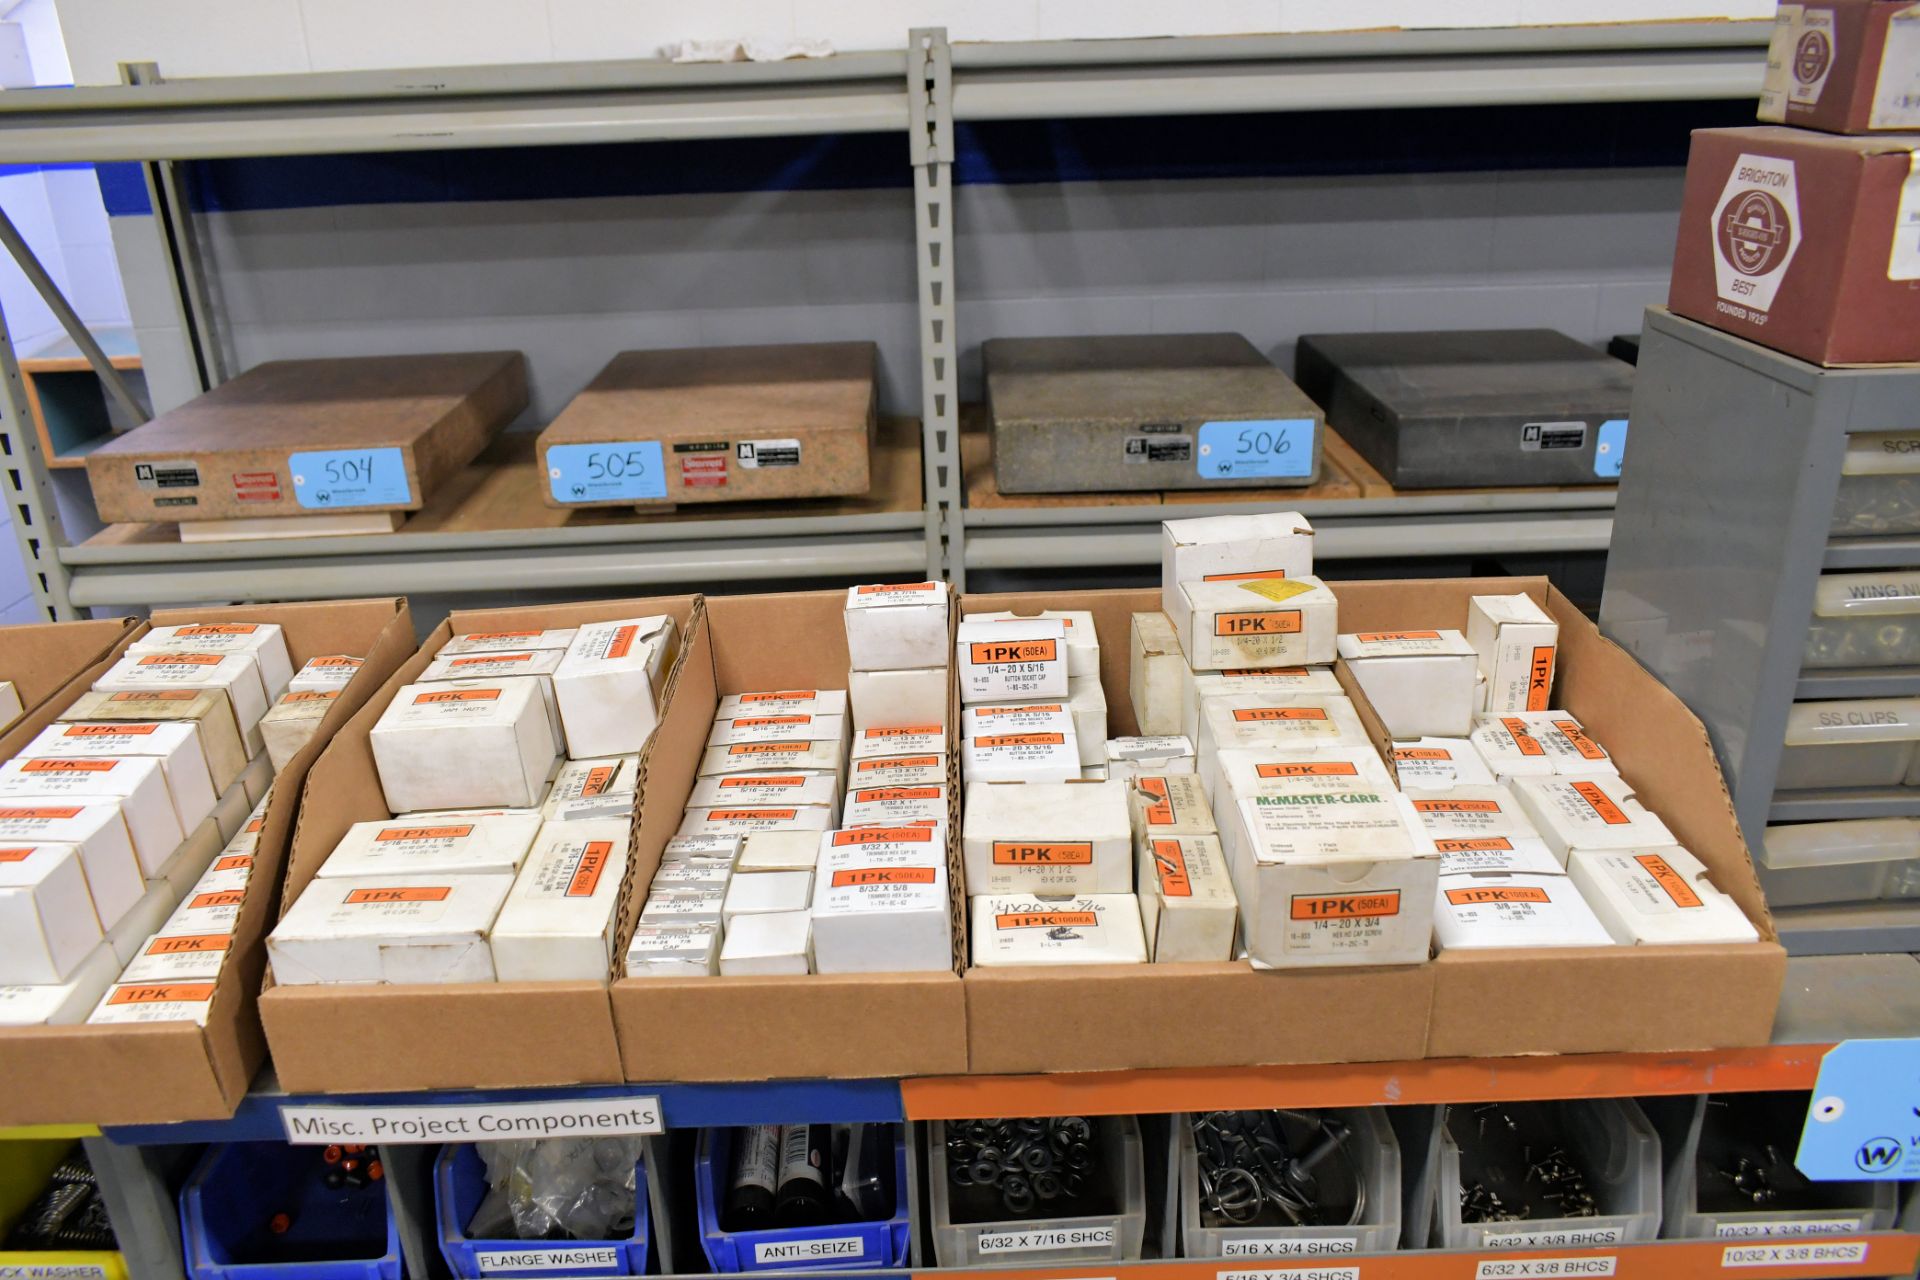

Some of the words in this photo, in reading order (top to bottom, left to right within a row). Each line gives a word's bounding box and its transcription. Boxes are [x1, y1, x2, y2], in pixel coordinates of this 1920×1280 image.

[1738, 167, 1789, 188] BRIGHTON
[1731, 279, 1757, 296] BEST
[1716, 301, 1746, 320] FOUNDED
[1236, 429, 1291, 454] 506
[325, 456, 373, 484] 504
[588, 452, 645, 479] 505
[1849, 585, 1898, 599] WING
[1227, 618, 1266, 632] 1PK
[983, 648, 1021, 660] 1PK
[1023, 646, 1047, 656] (50EA)
[1028, 663, 1045, 672] 5/16
[1533, 657, 1547, 689] 1PK
[428, 692, 465, 701] 1PK
[1819, 712, 1844, 726] SS
[1848, 712, 1899, 725] CLIPS
[1561, 725, 1584, 742] 1PK
[1272, 766, 1317, 775] 1PK
[1581, 786, 1605, 806] 1PK
[847, 832, 889, 842] 1PK
[1007, 848, 1051, 860] 1PK
[579, 850, 600, 873] 1PK
[1019, 866, 1045, 874] 1/4-20
[1059, 865, 1072, 873] 1/2
[1645, 860, 1671, 878] 1PK
[848, 872, 892, 883] 1PK
[362, 892, 404, 900] 1PK
[1461, 891, 1507, 901] 1PK
[1307, 900, 1355, 914] 1PK
[1358, 899, 1388, 910] (50EA)
[1011, 917, 1055, 926] 1PK
[1354, 919, 1360, 927] X
[1365, 918, 1380, 927] 3/4
[163, 939, 206, 951] 1PK
[127, 988, 172, 1000] 1PK
[293, 1117, 364, 1136] Misc.
[373, 1116, 470, 1137] Project
[478, 1108, 655, 1134] Components
[981, 1238, 1013, 1249] 6/32
[1018, 1236, 1029, 1247] X
[1035, 1234, 1066, 1246] 7/16
[1071, 1231, 1113, 1243] SHCS
[1542, 1234, 1566, 1245] 3/8
[1570, 1232, 1616, 1244] BHCS
[764, 1241, 858, 1258] ANTI-SEIZE
[1226, 1244, 1258, 1255] 5/16
[1264, 1244, 1274, 1254] X
[1279, 1242, 1301, 1254] 3/4
[1307, 1242, 1353, 1253] SHCS
[1725, 1251, 1764, 1262] 10/32
[1769, 1250, 1780, 1260] X
[1785, 1248, 1809, 1259] 3/8
[1814, 1246, 1859, 1258] BHCS
[481, 1252, 544, 1267] FLANGE
[29, 1267, 103, 1277] WASHER
[1482, 1264, 1515, 1276] 6/32
[1520, 1264, 1531, 1274] X
[1536, 1263, 1559, 1273] 3/8
[1564, 1261, 1609, 1272] BHCS
